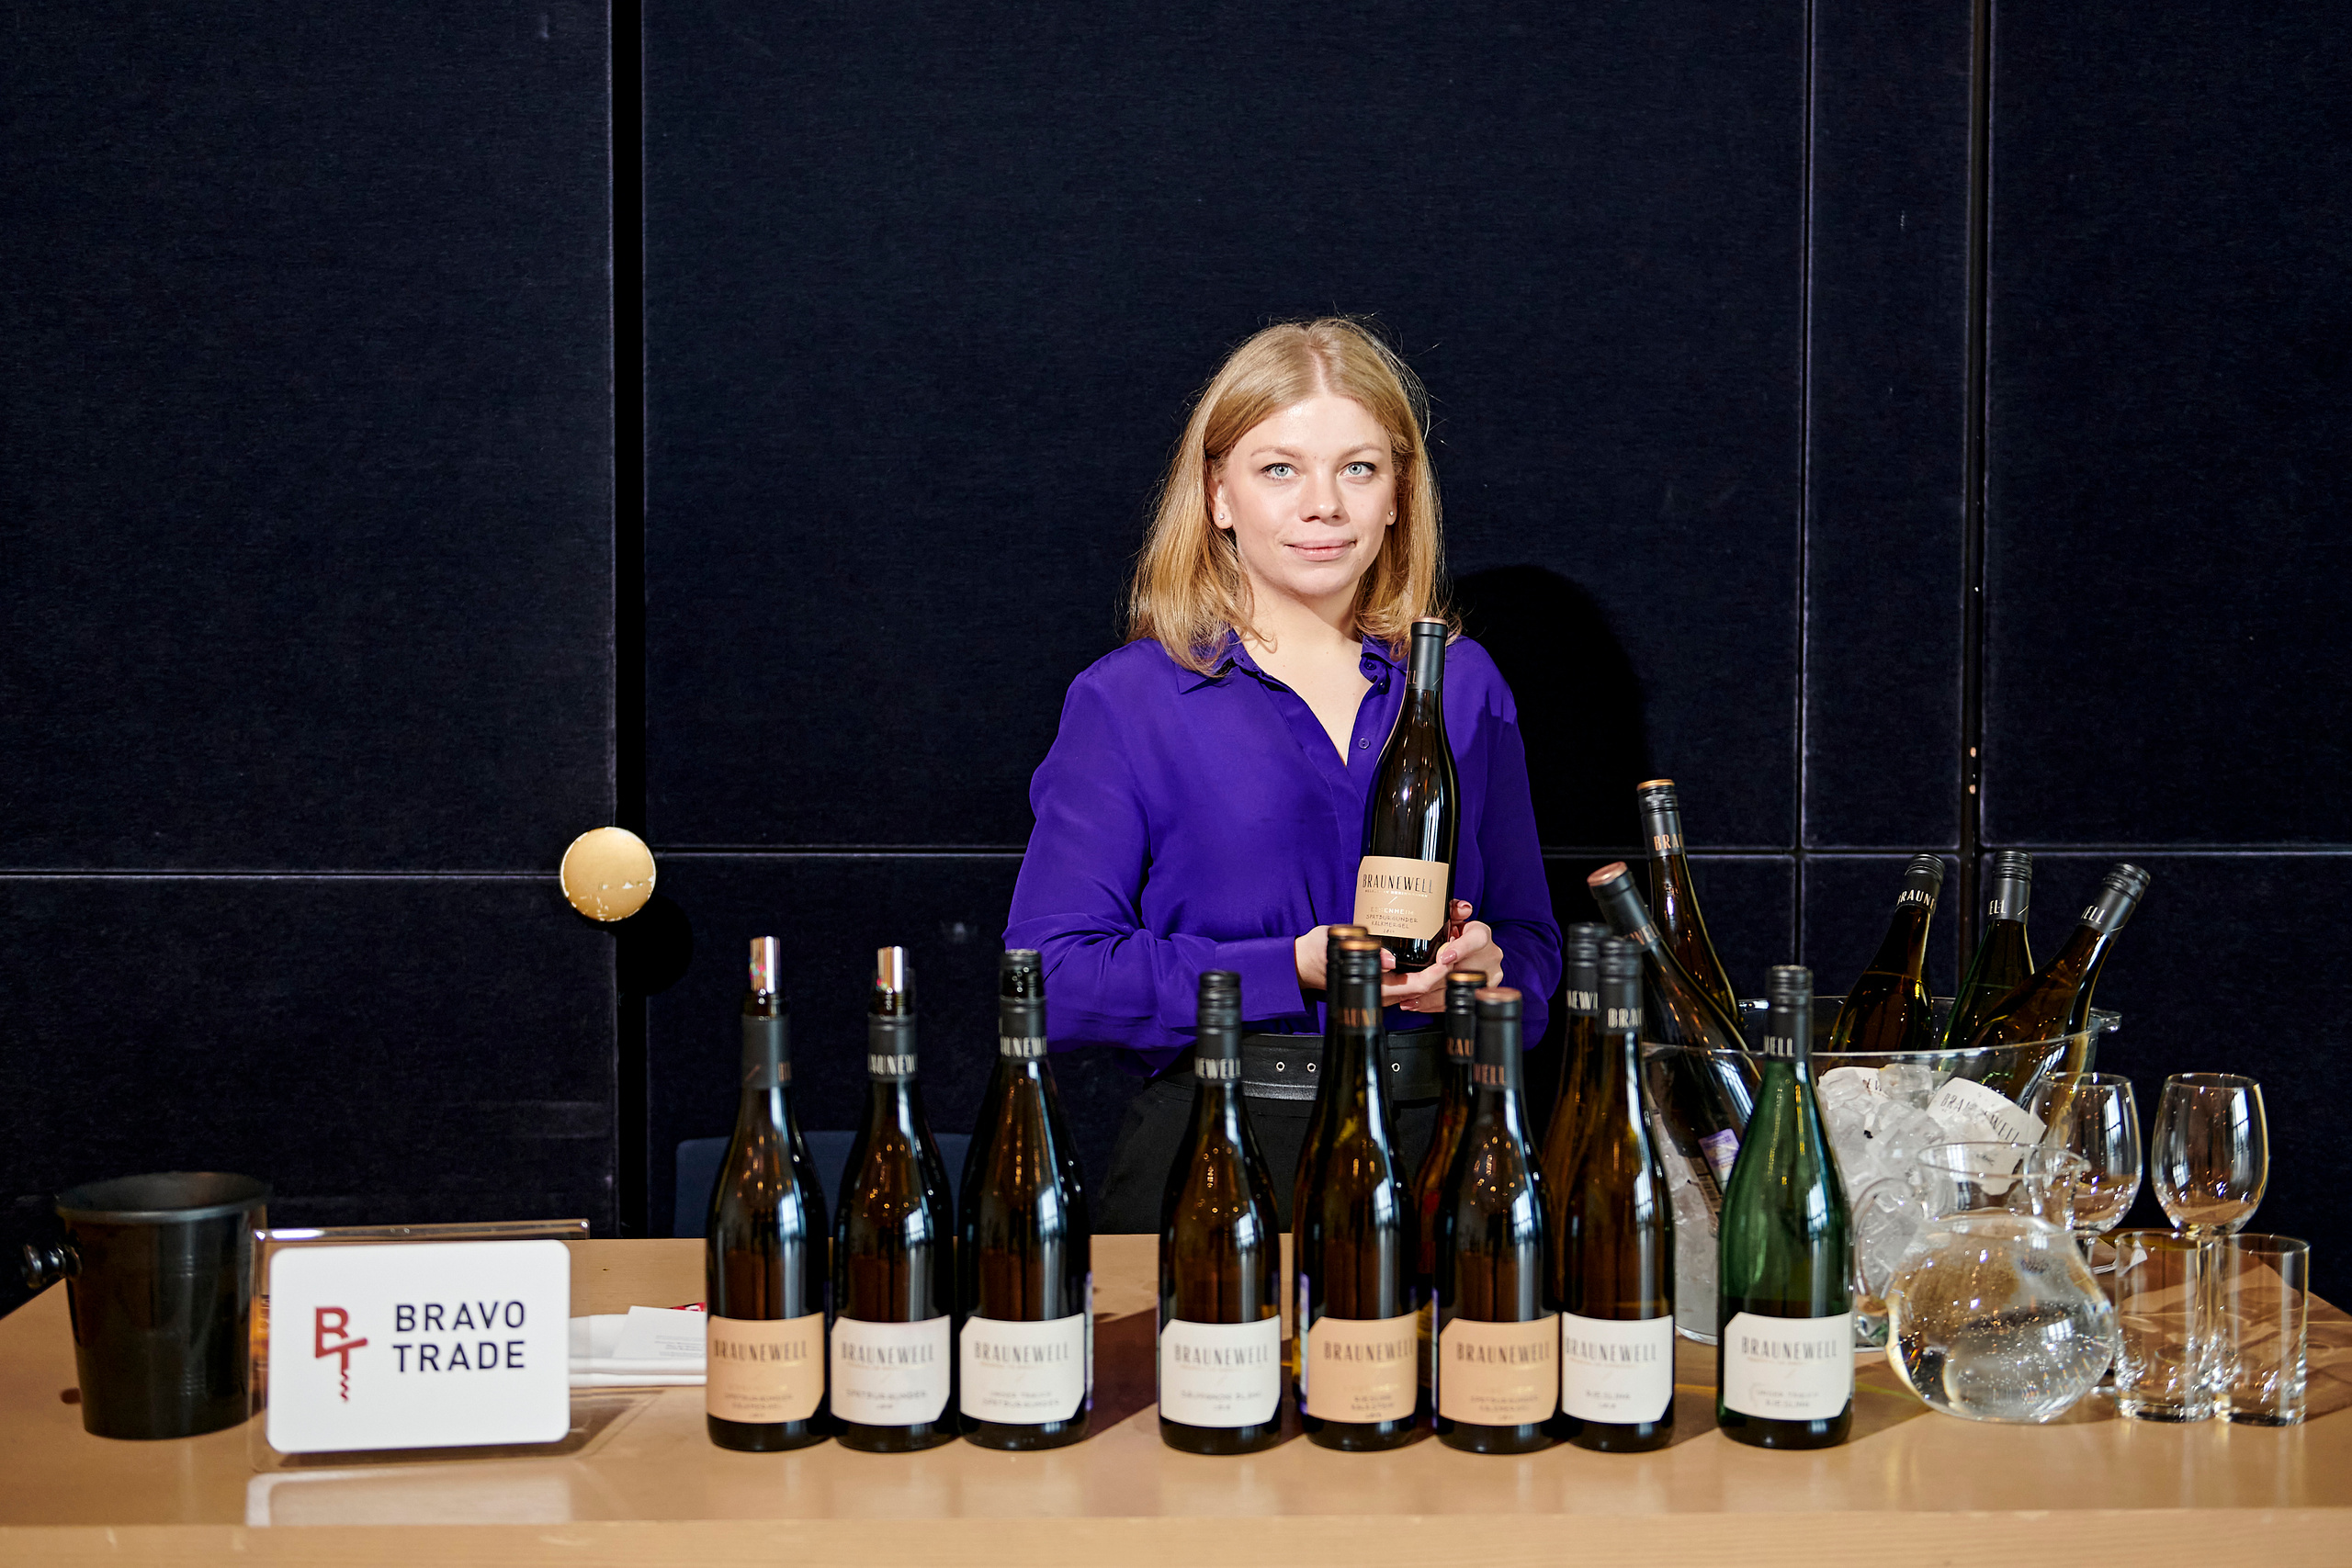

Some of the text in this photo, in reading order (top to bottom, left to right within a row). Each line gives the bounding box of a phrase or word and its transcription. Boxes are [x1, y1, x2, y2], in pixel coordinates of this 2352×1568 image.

[1362, 874, 1433, 895] BRAUNEWELL
[2081, 906, 2106, 925] ELL
[395, 1301, 526, 1333] BRAVO
[392, 1340, 526, 1372] TRADE
[714, 1340, 808, 1361] BRAUNEWELL
[842, 1342, 934, 1364] BRAUNEWELL
[974, 1341, 1069, 1363] BRAUNEWELL
[1174, 1343, 1268, 1365] BRAUNEWELL
[1324, 1337, 1415, 1361] BRAUNEWELL
[1456, 1342, 1550, 1363] BRAUNEWELL
[1566, 1337, 1657, 1361] BRAUNEWELL
[1741, 1336, 1838, 1359] BRAUNEWELL
